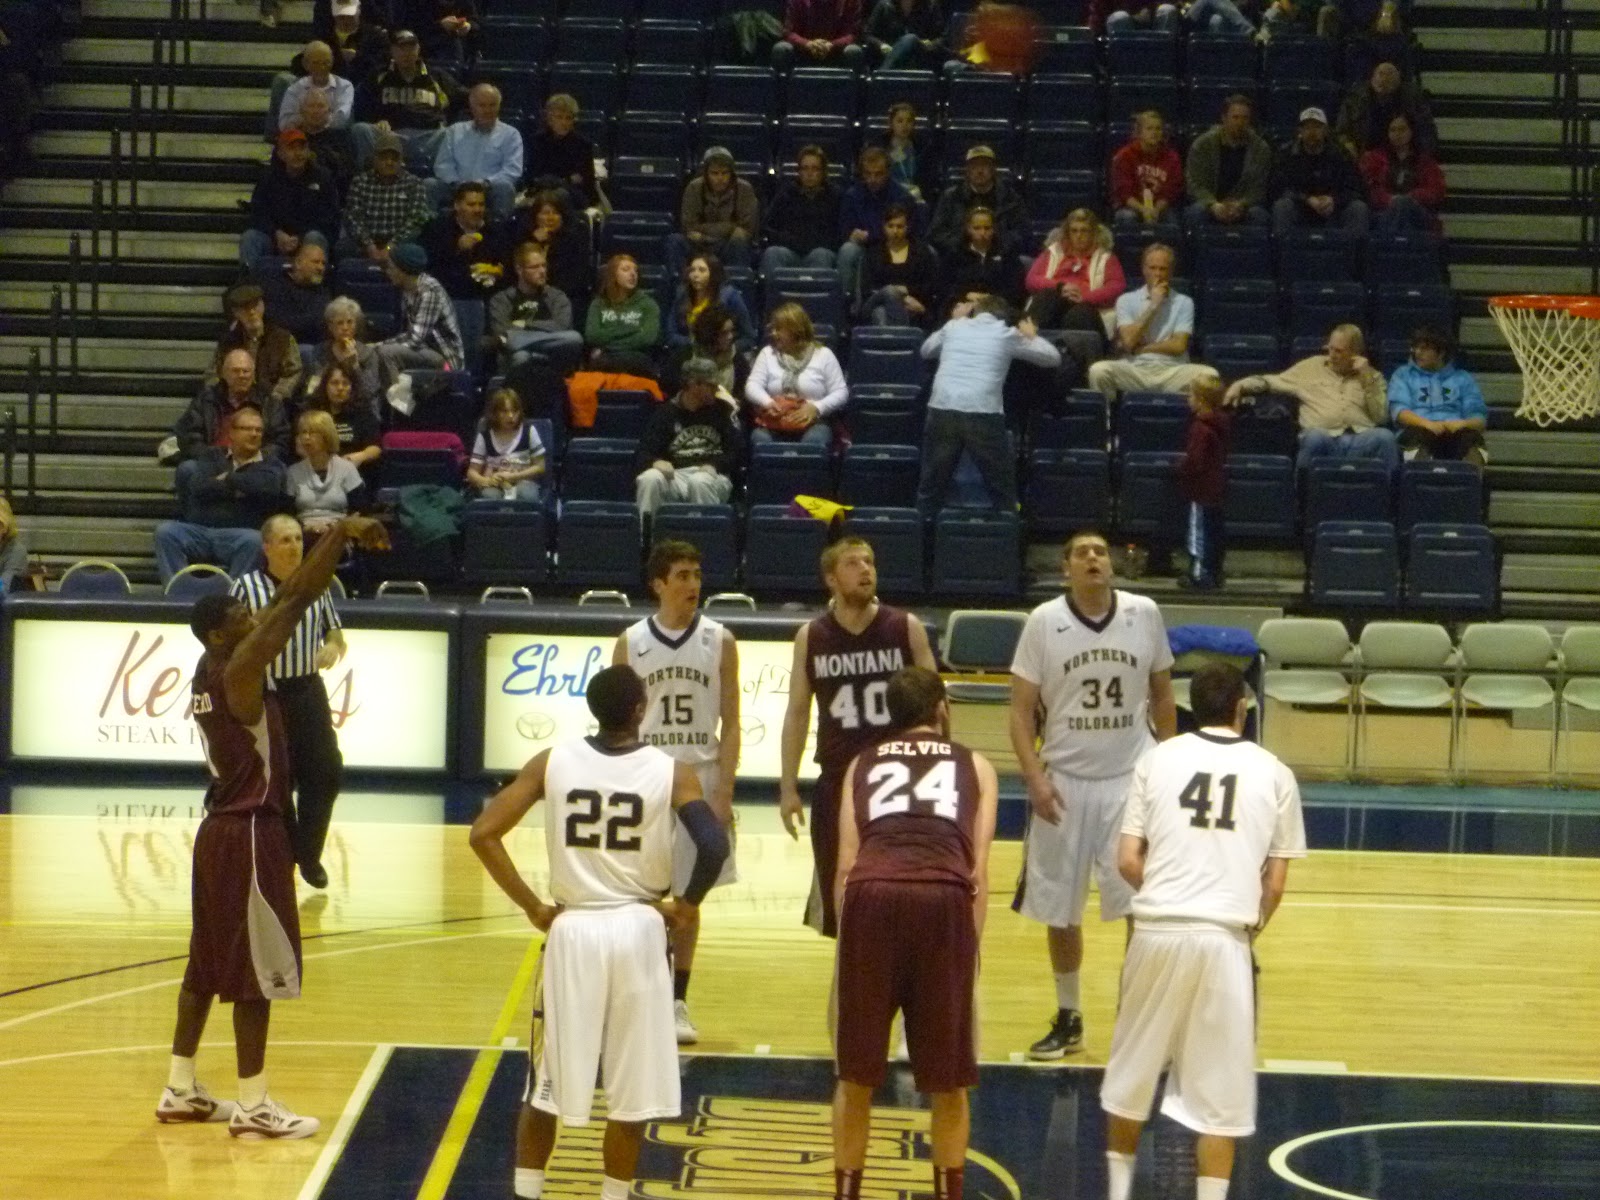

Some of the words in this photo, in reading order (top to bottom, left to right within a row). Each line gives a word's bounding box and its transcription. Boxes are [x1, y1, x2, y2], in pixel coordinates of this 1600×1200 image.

[813, 648, 904, 679] MONTANA
[1063, 648, 1137, 675] NORTHERN
[829, 680, 892, 729] 40
[1082, 676, 1123, 709] 34
[660, 694, 693, 725] 15
[1068, 714, 1134, 730] COLORADO
[97, 725, 178, 745] STEAK
[643, 732, 709, 746] COLORADO
[877, 740, 952, 757] SELVIG
[867, 760, 959, 822] 24
[1178, 771, 1238, 831] 41
[565, 788, 644, 851] 22
